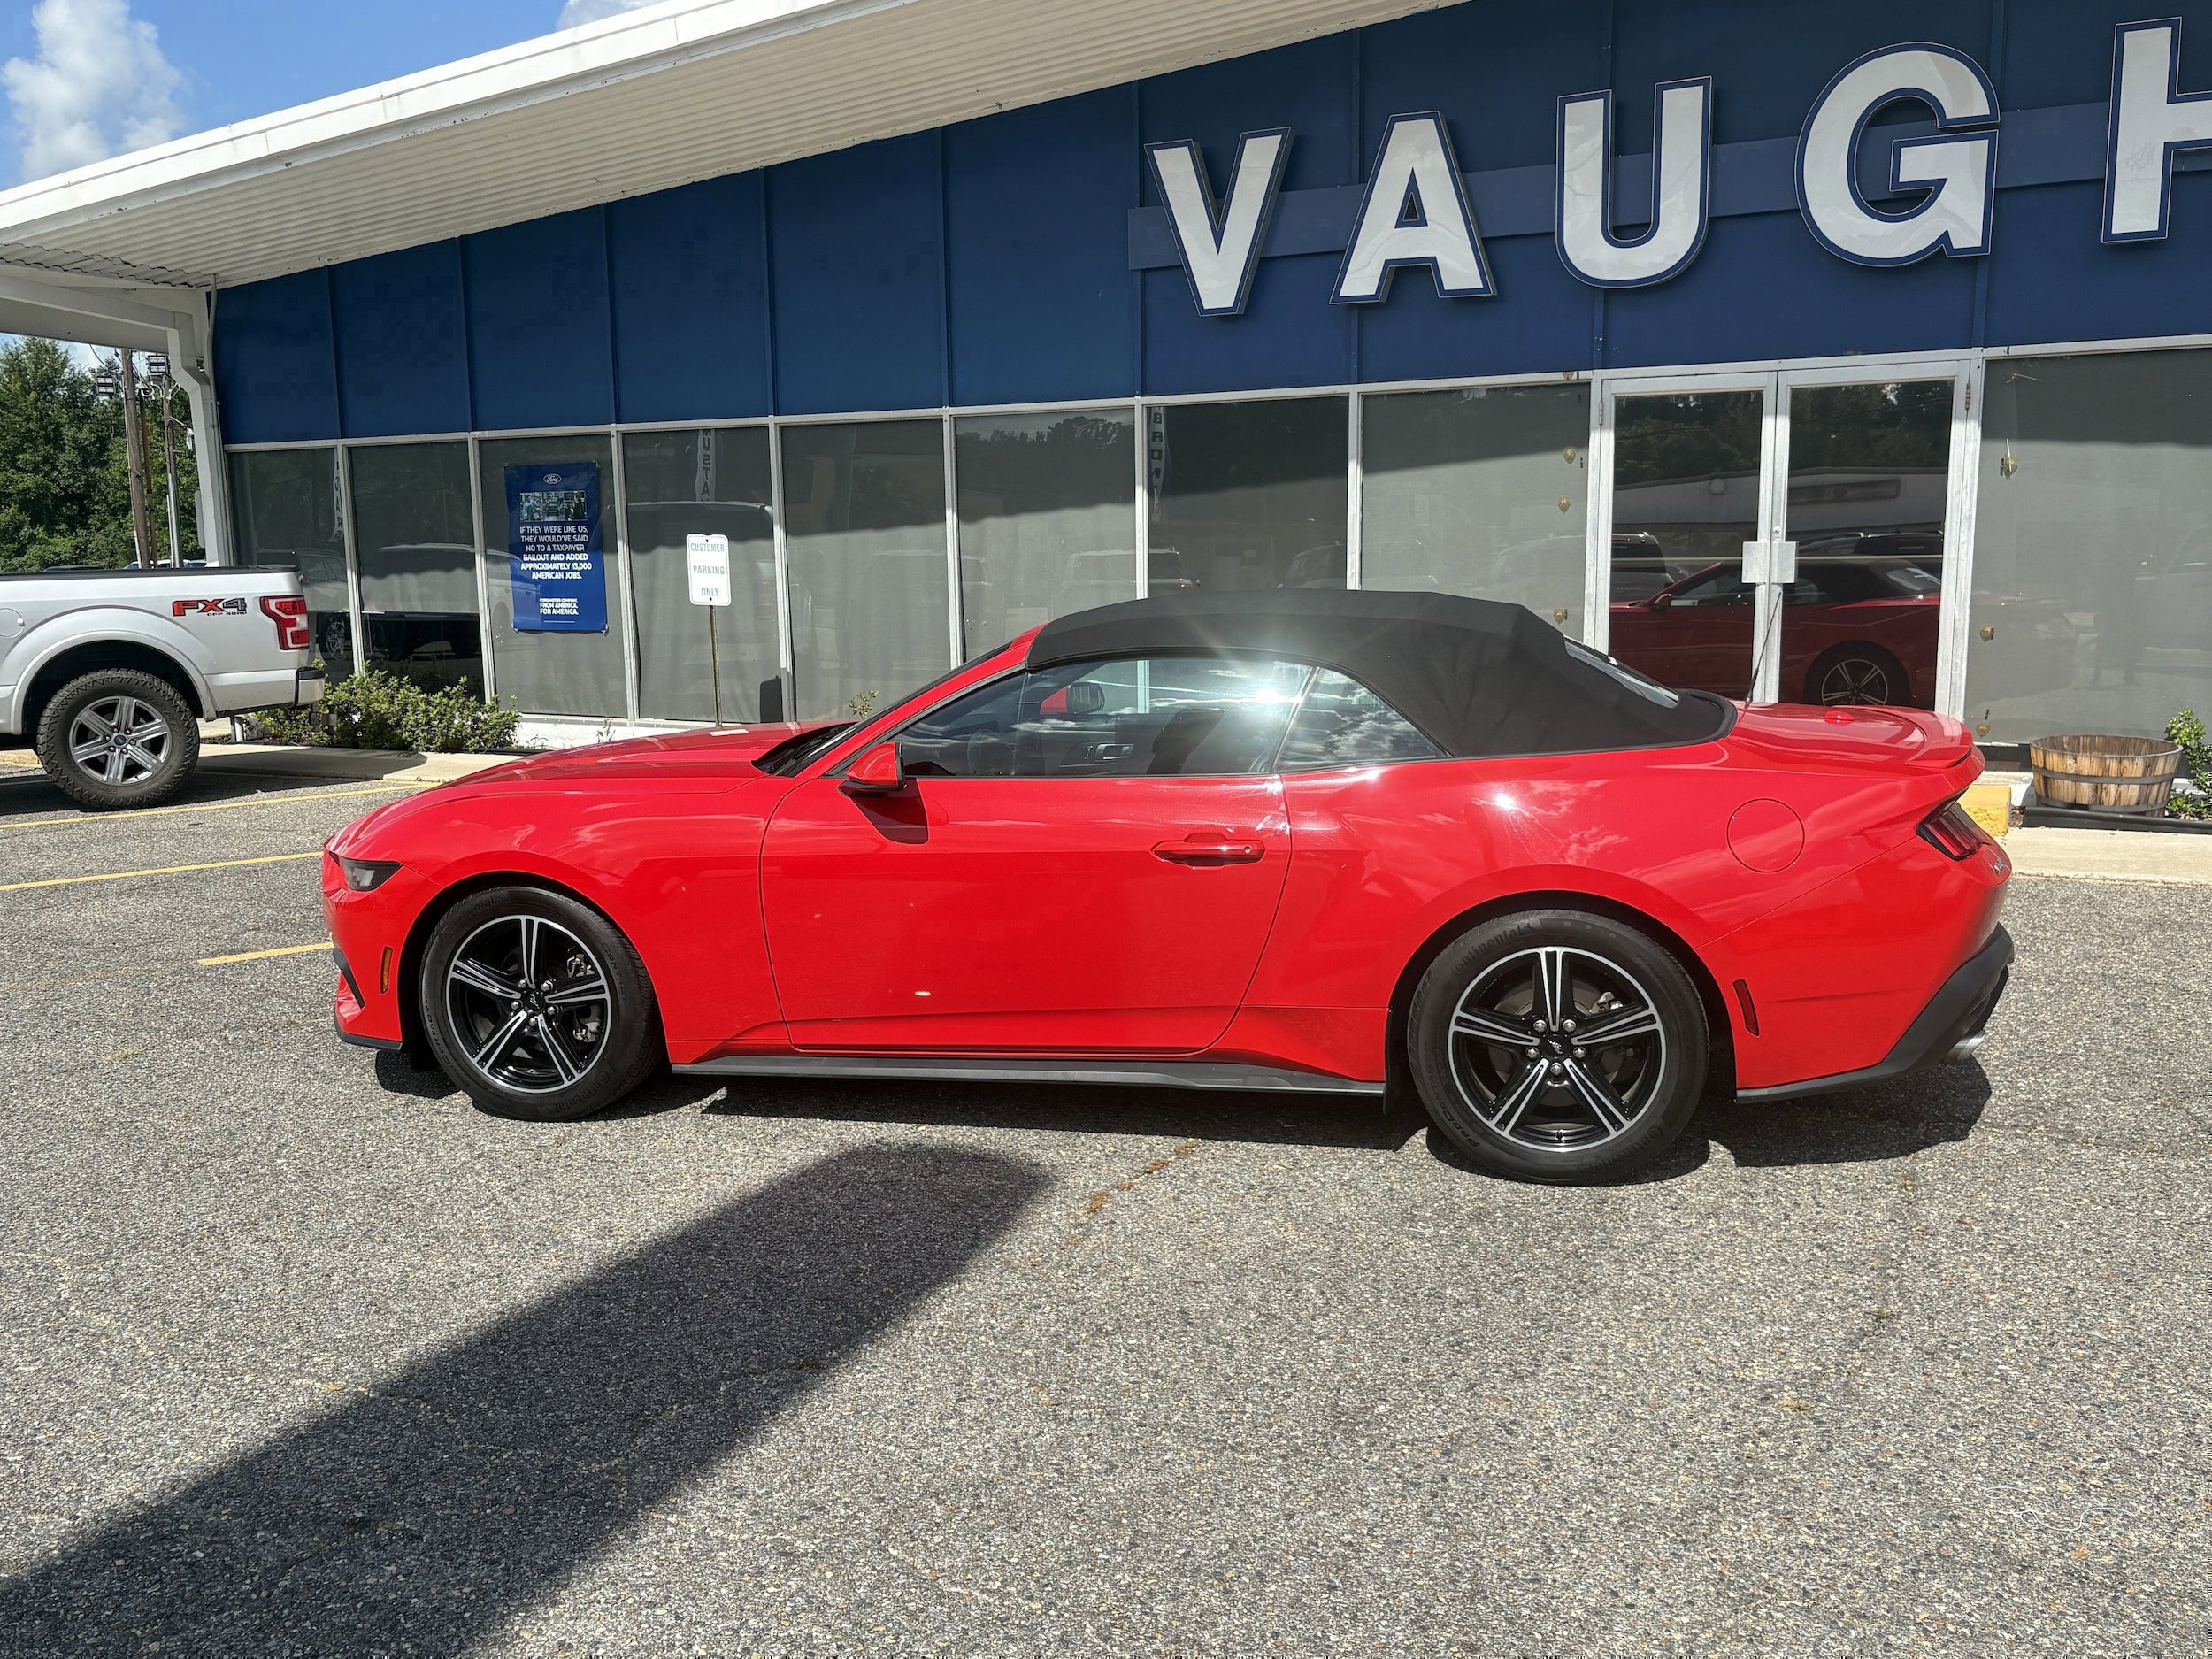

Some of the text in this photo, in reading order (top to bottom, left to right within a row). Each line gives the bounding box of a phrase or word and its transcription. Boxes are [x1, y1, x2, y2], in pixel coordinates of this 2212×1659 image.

[577, 525, 588, 534] US,
[691, 542, 725, 553] CUSTOMER
[693, 565, 725, 575] PARKING
[701, 588, 718, 596] ONLY
[172, 598, 247, 617] FX4
